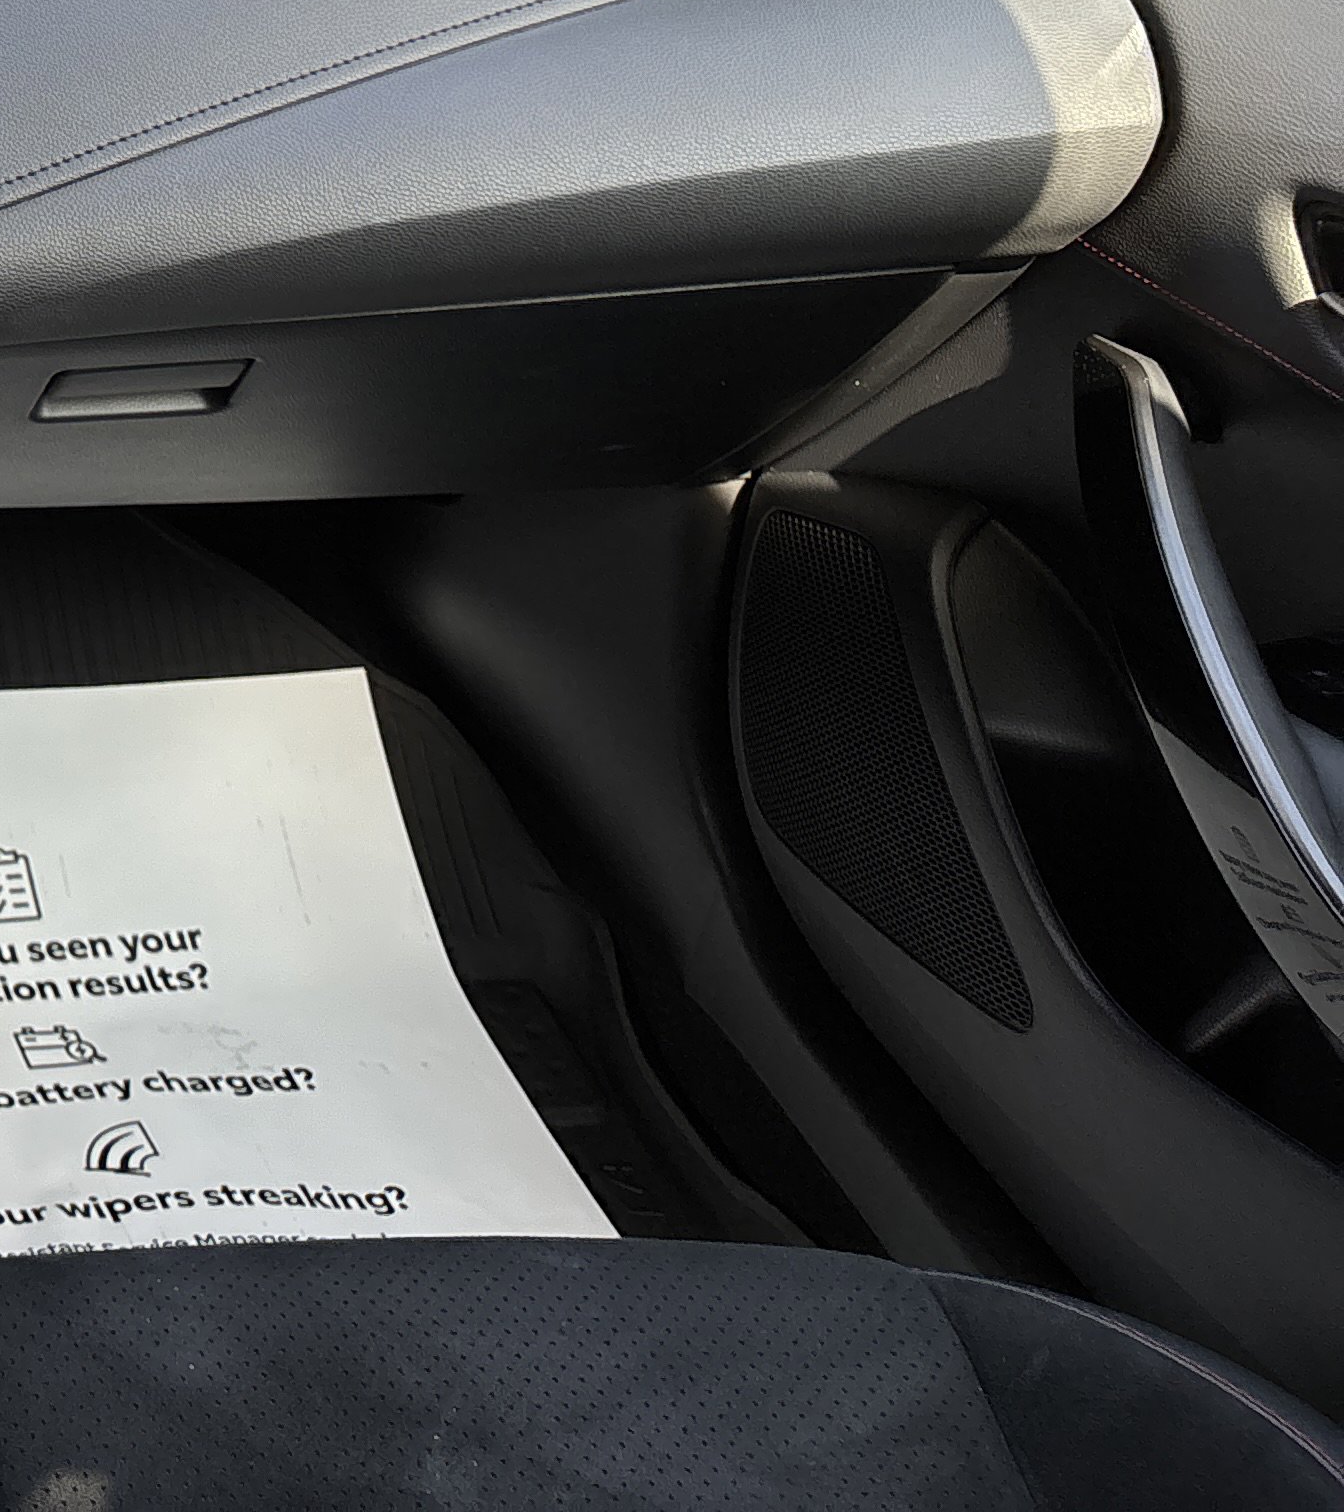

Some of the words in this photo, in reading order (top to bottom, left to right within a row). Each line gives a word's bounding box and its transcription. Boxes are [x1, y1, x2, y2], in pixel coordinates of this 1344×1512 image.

[28, 935, 113, 963] seen
[118, 928, 202, 962] your
[68, 962, 209, 999] results?
[142, 1066, 317, 1099] charged?
[55, 1187, 196, 1223] wipers
[203, 1184, 410, 1215] streaking?
